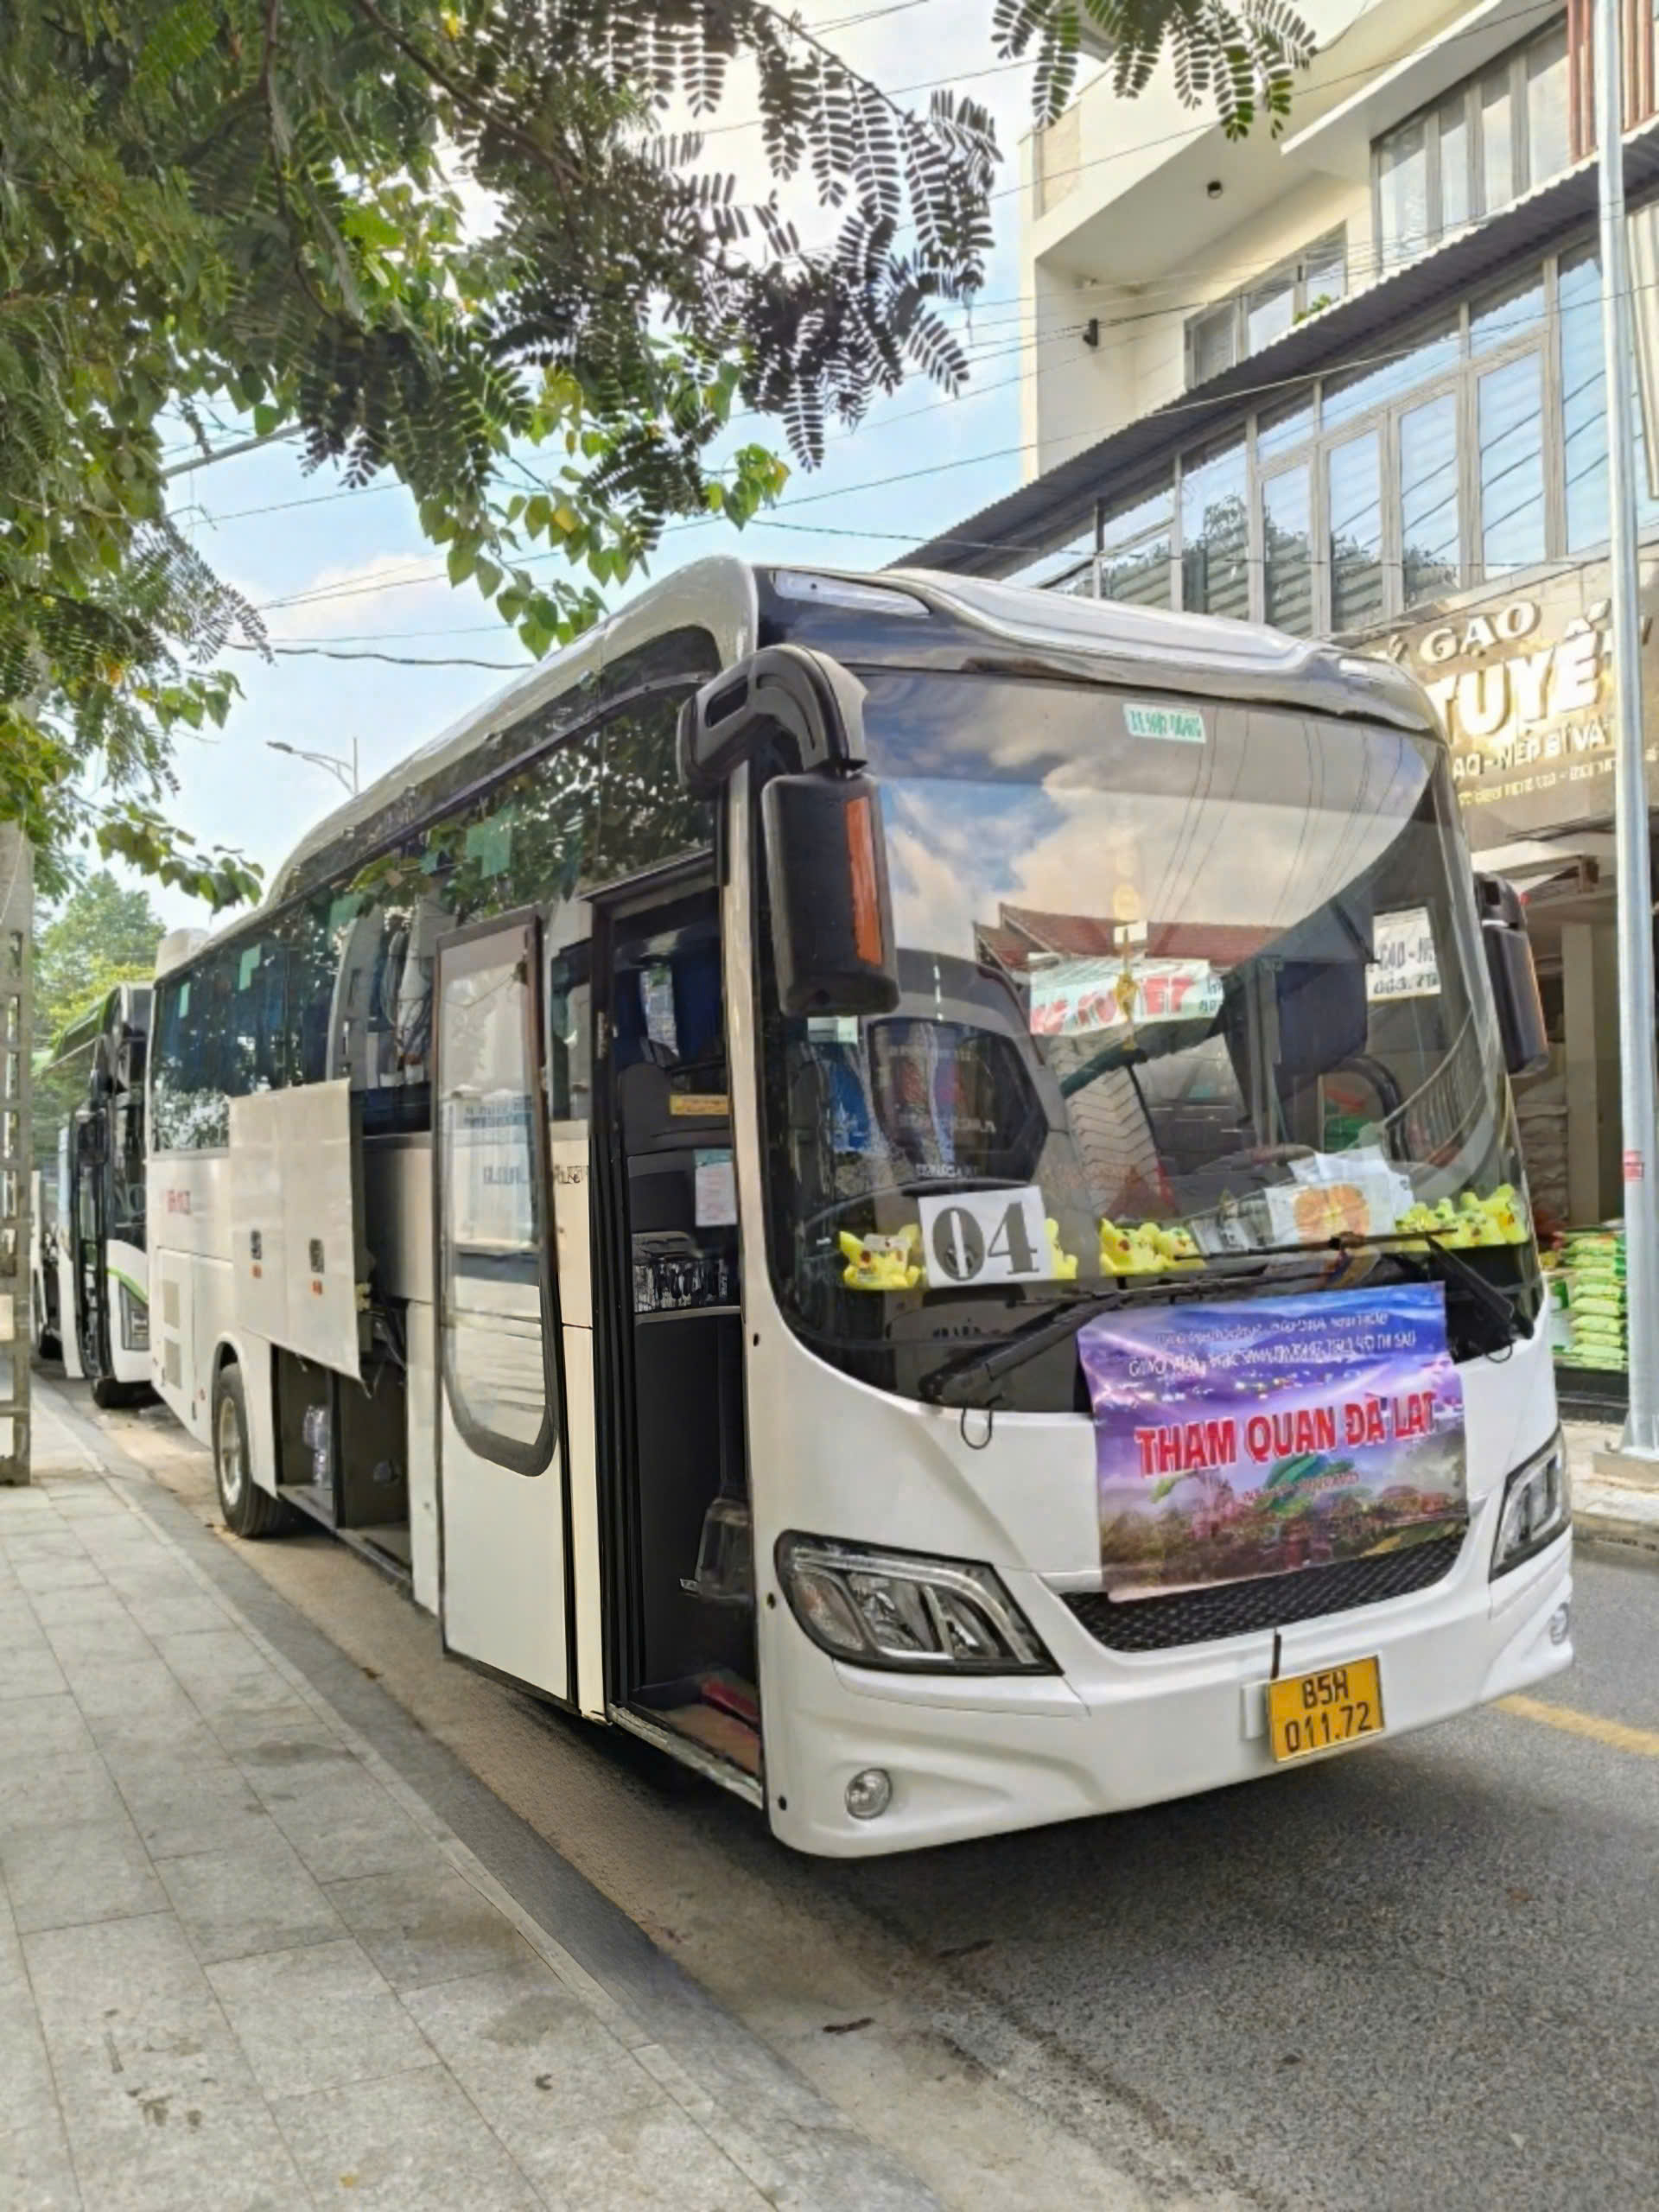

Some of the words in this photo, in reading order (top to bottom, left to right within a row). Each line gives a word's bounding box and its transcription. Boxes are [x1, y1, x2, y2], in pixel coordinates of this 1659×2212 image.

[933, 1201, 1040, 1281] 04
[1135, 1419, 1236, 1475] THAM
[1245, 1406, 1336, 1464] QUAN
[1285, 1701, 1372, 1753] 011.72
